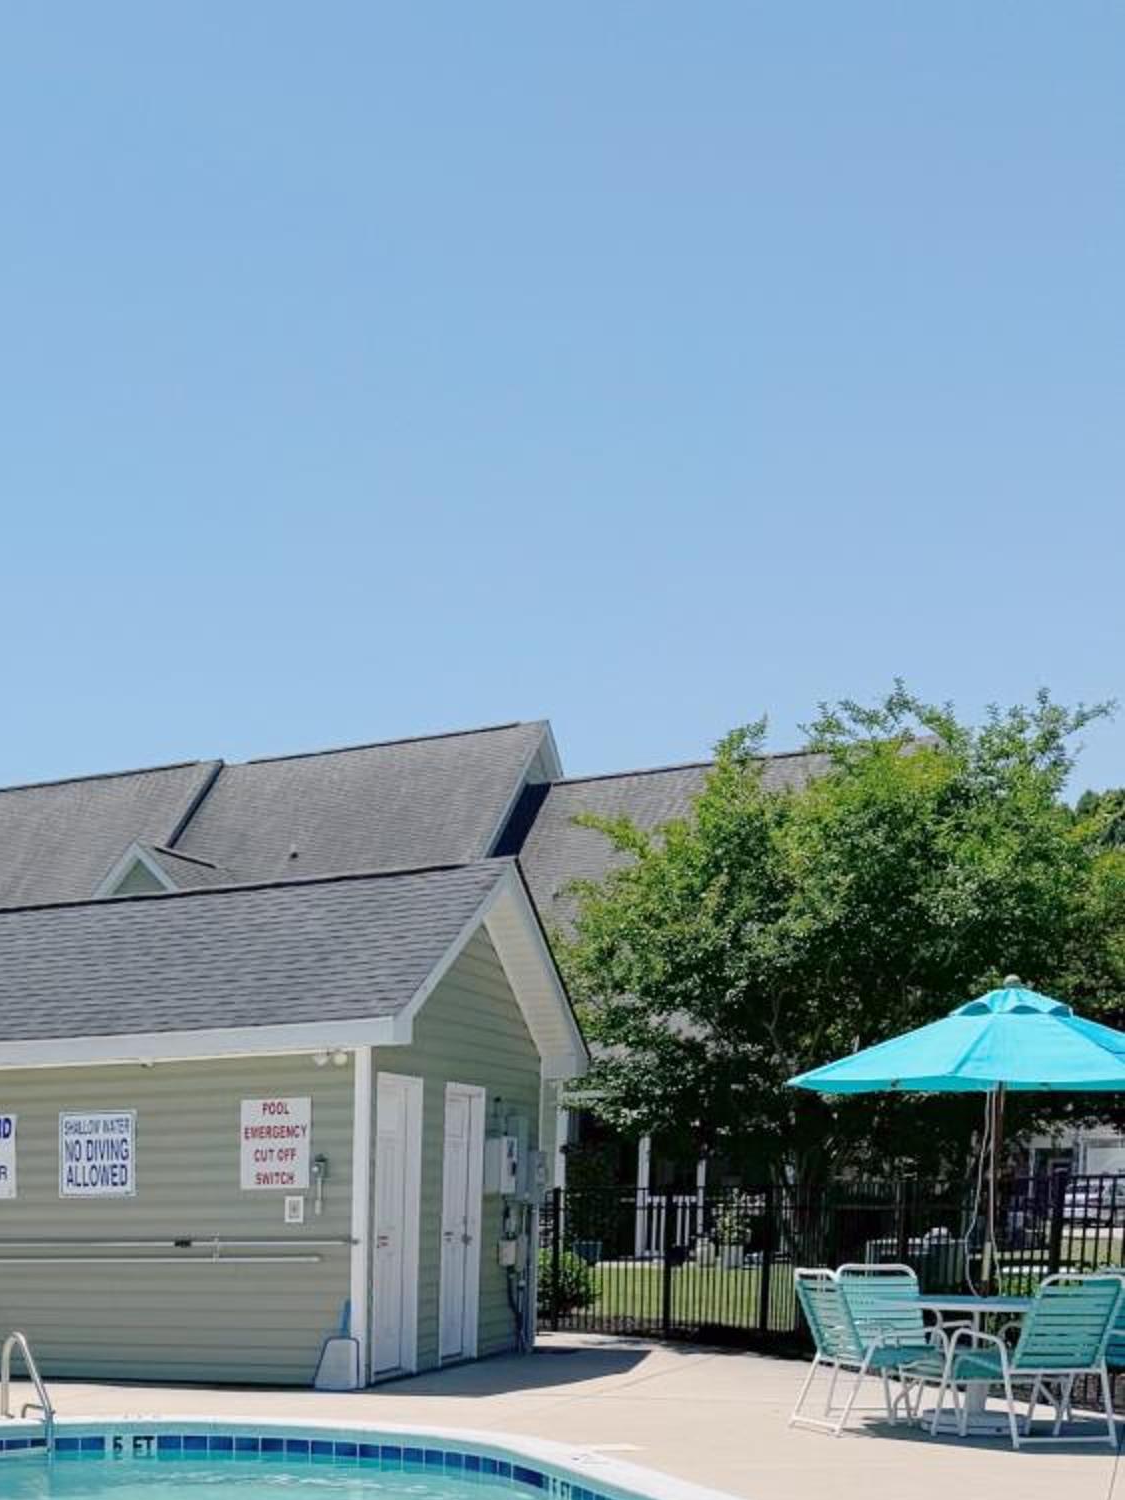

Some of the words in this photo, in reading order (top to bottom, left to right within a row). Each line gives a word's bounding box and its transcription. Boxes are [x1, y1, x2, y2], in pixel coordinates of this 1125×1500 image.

[262, 1101, 290, 1115] POOL
[64, 1118, 100, 1135] SHALLOW
[102, 1117, 130, 1133] WATER
[244, 1124, 308, 1140] EMERGENCY
[65, 1139, 82, 1162] NO
[86, 1137, 129, 1161] DIVING
[254, 1149, 275, 1162] CUT
[277, 1147, 297, 1161] OFF
[66, 1164, 128, 1187] ALLOWED
[256, 1171, 295, 1185] SWITCH
[132, 1435, 155, 1451] FT
